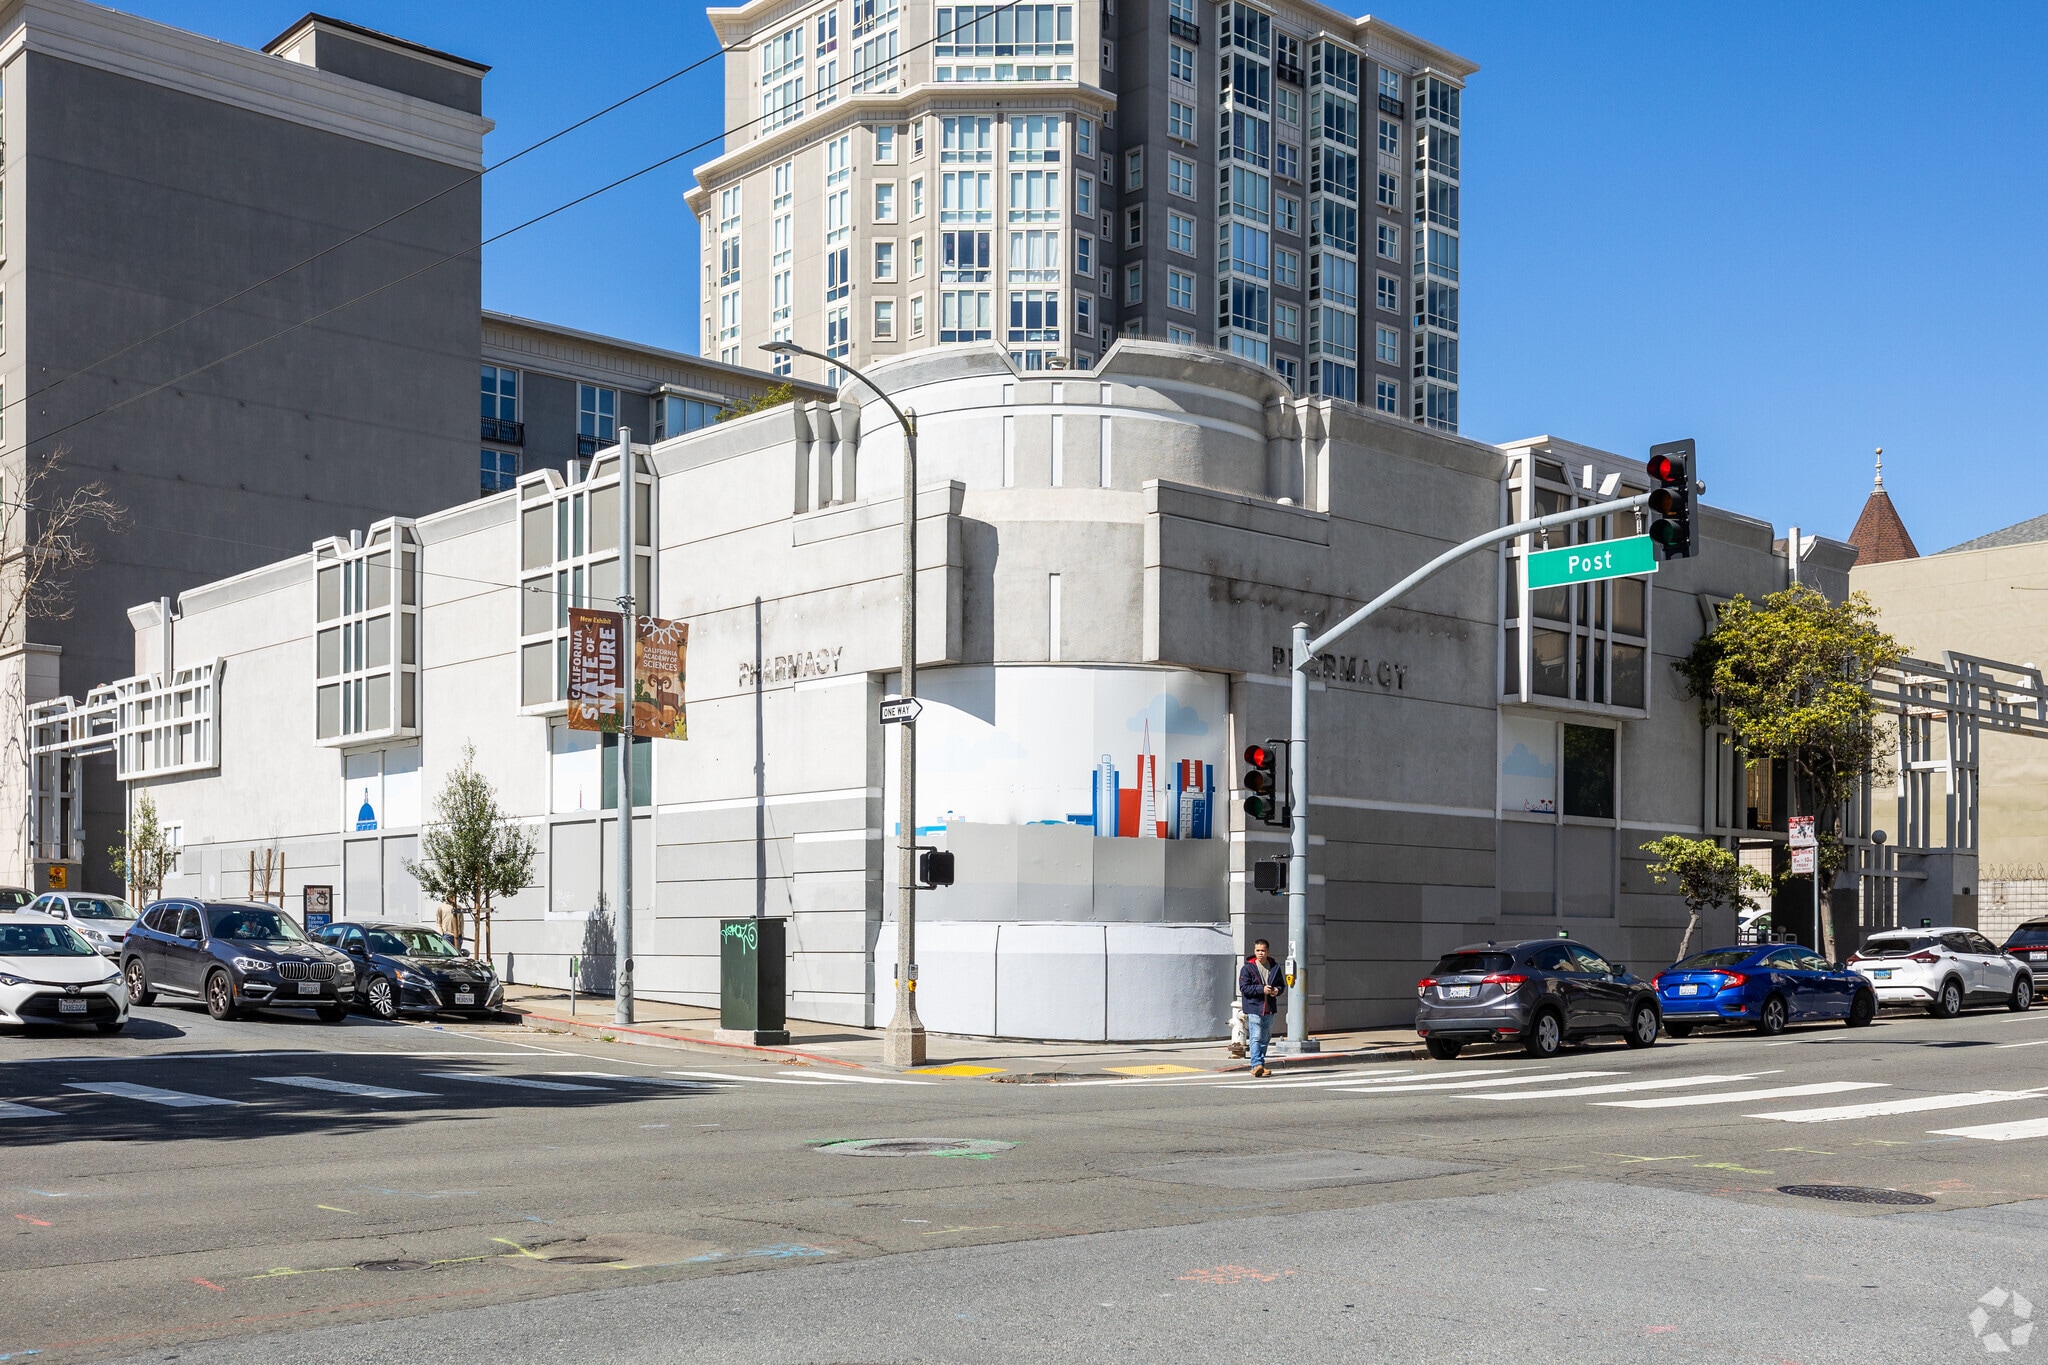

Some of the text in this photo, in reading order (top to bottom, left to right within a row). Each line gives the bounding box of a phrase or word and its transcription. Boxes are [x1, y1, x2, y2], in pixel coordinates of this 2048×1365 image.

[1568, 550, 1612, 575] Post
[580, 615, 612, 625] New Exhibit
[571, 629, 583, 699] CALIFORNIA
[643, 646, 678, 657] CALIFORNIA
[643, 653, 671, 662] ACADEMY
[599, 627, 616, 715] NATURE
[643, 659, 678, 671] SCIENCES
[738, 646, 843, 687] PHARMACY
[1272, 646, 1408, 690] PRMACY
[581, 636, 599, 720] STATE OF
[883, 705, 910, 717] ONE WAY
